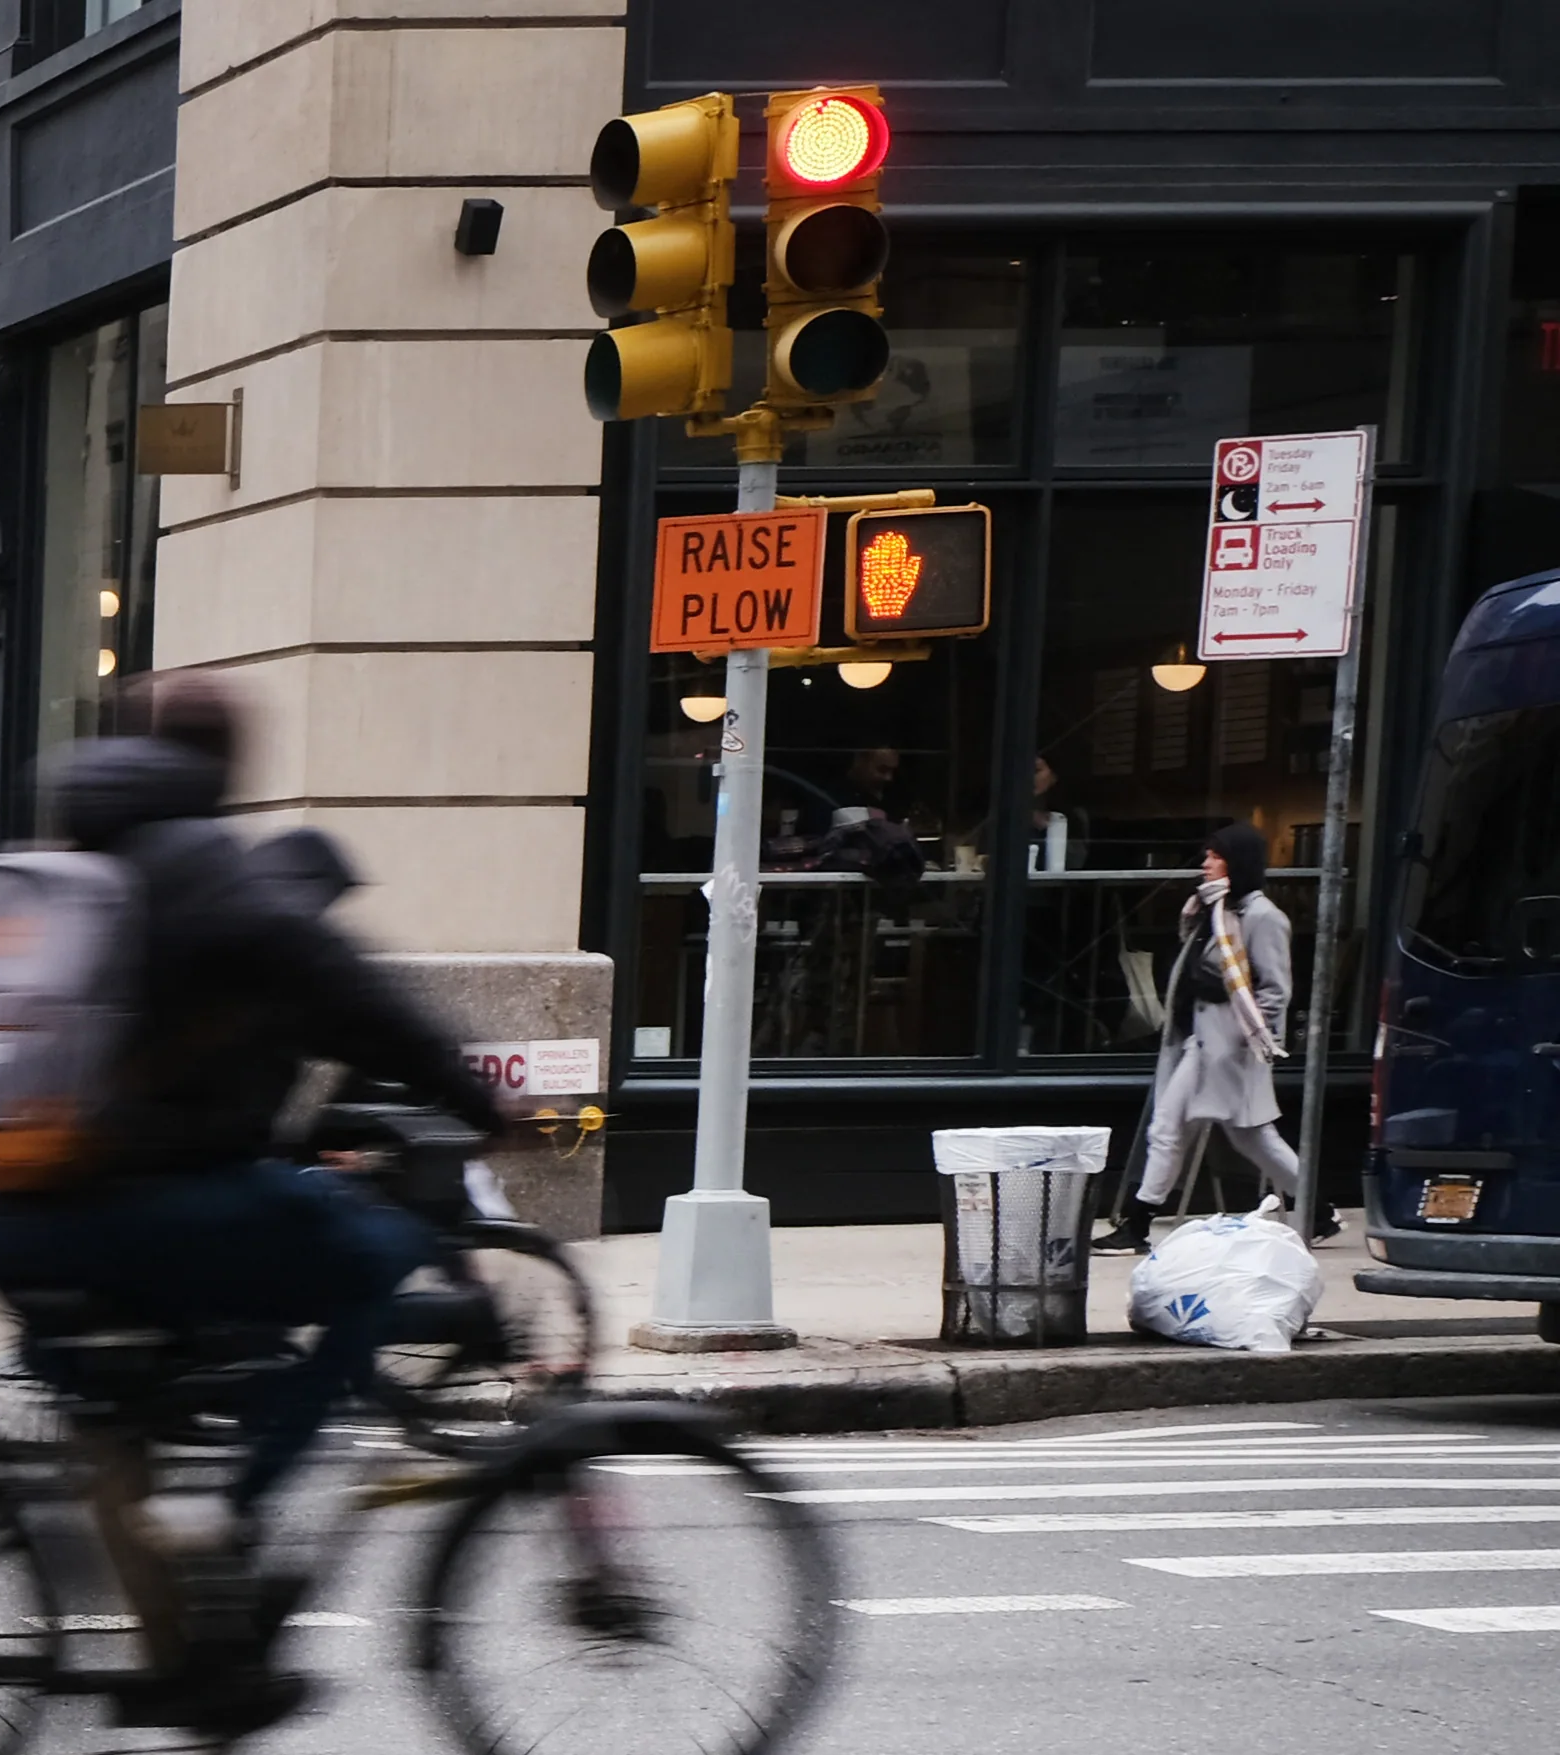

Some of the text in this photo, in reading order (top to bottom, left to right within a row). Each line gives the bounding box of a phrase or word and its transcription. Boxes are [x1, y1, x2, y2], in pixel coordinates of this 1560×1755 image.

[1268, 449, 1314, 460] Tuesday
[1267, 463, 1301, 475] Friday
[1266, 482, 1290, 492] 2am
[1301, 481, 1325, 491] 6am
[1266, 528, 1303, 540] Truck
[681, 524, 797, 574] RAISE
[1265, 543, 1317, 556] Loading
[1263, 557, 1293, 571] Only
[1213, 586, 1263, 599] Monday
[1277, 583, 1317, 597] Friday
[681, 588, 792, 636] PLOW
[1213, 605, 1238, 617] 7am
[1252, 603, 1279, 617] 7pm
[537, 1050, 589, 1061] SPRINKLERS
[534, 1064, 592, 1075] THROUGHOUT
[543, 1079, 582, 1090] BUILDING
